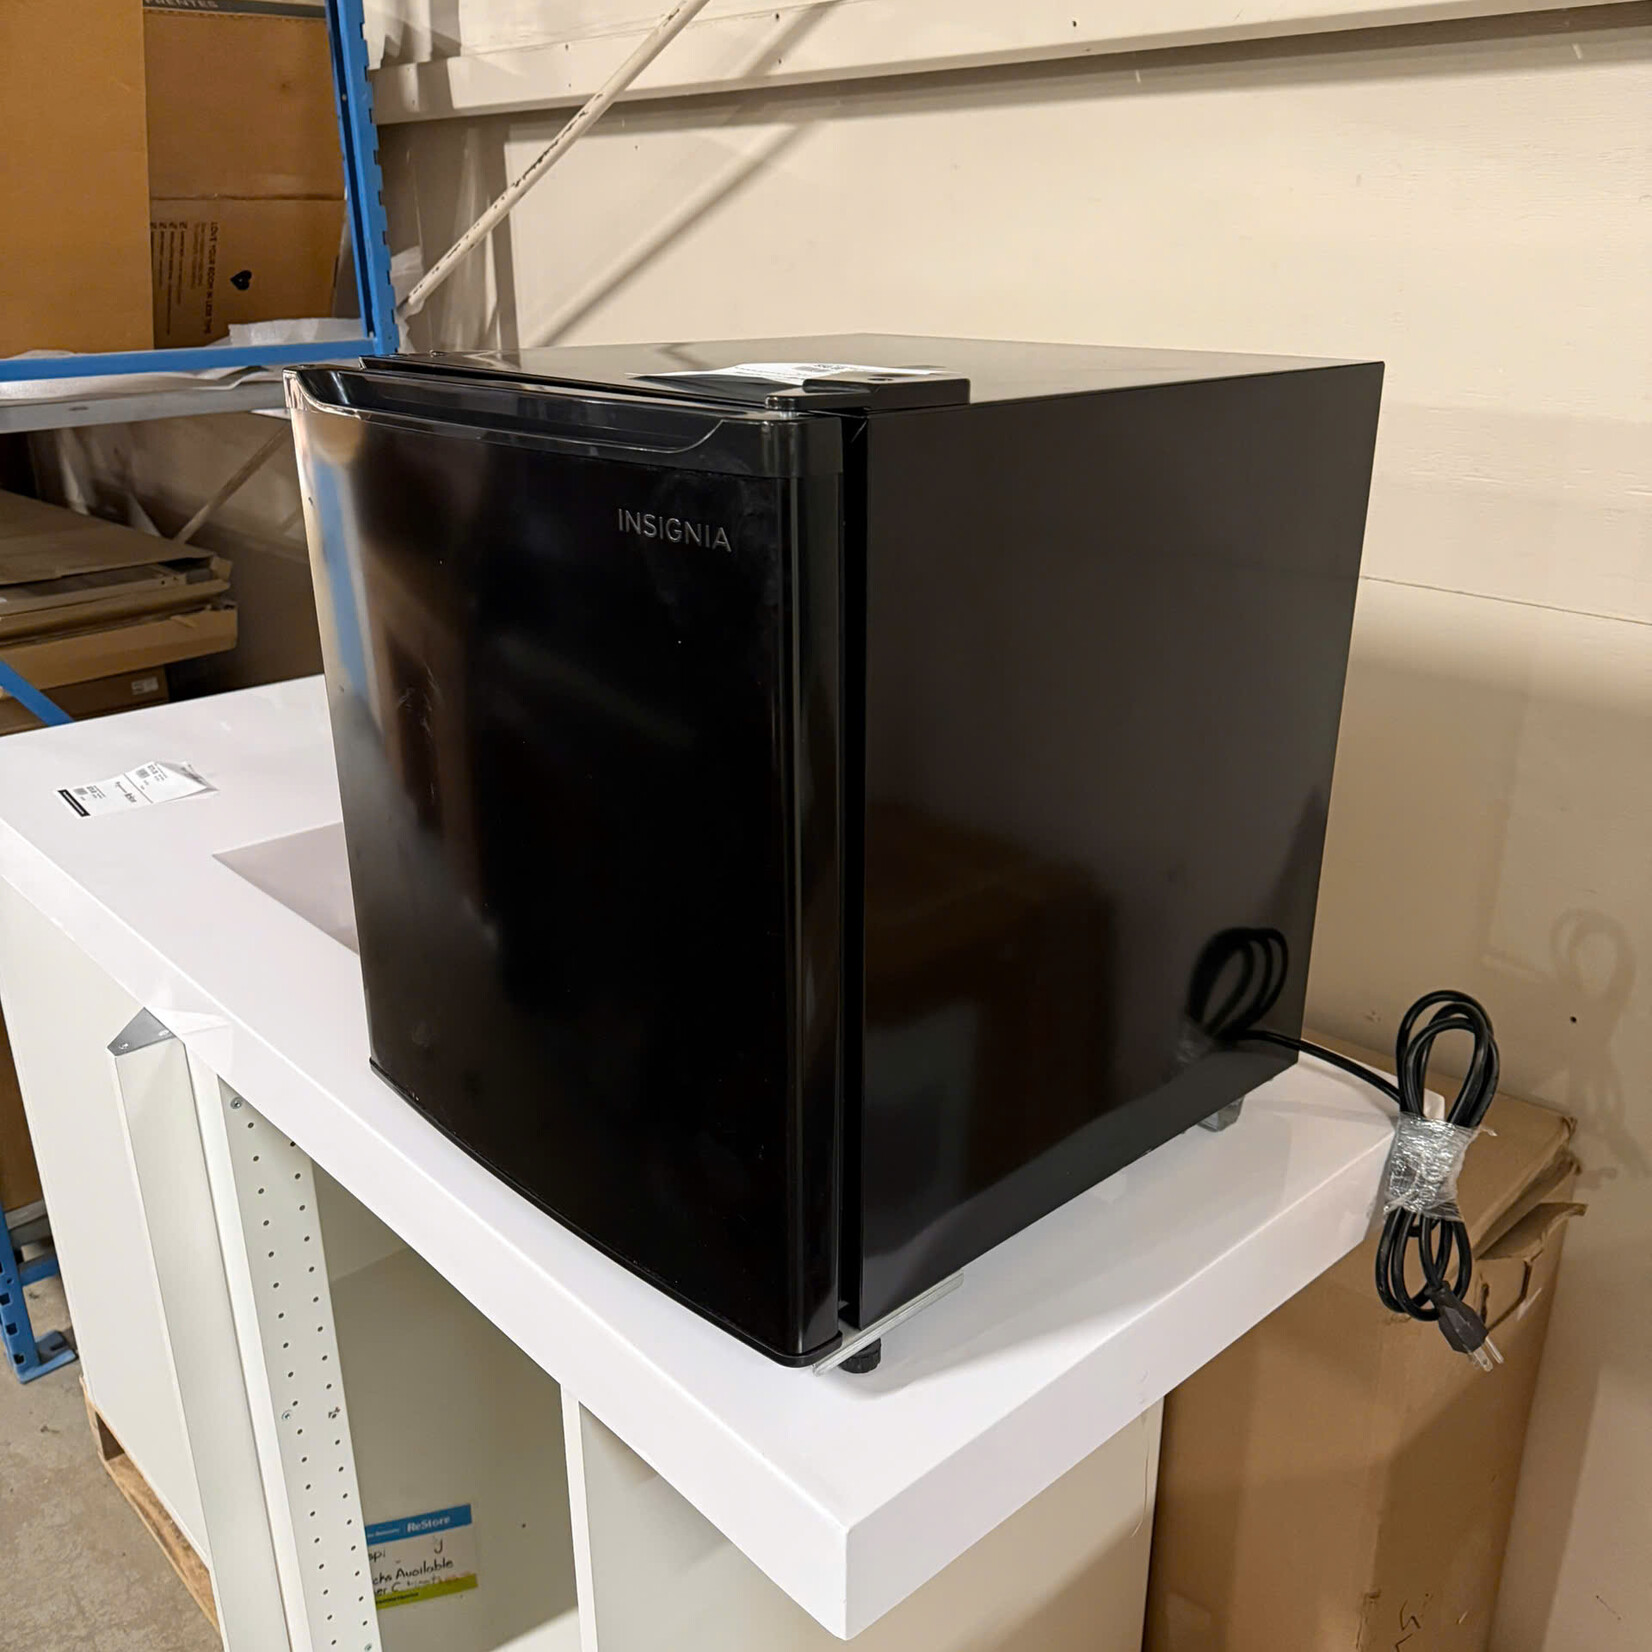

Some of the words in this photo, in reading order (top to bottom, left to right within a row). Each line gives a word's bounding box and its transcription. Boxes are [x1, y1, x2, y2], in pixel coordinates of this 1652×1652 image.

[618, 508, 732, 552] INSIGNIA
[407, 1516, 451, 1533] ReStore
[396, 1557, 454, 1579] Available
